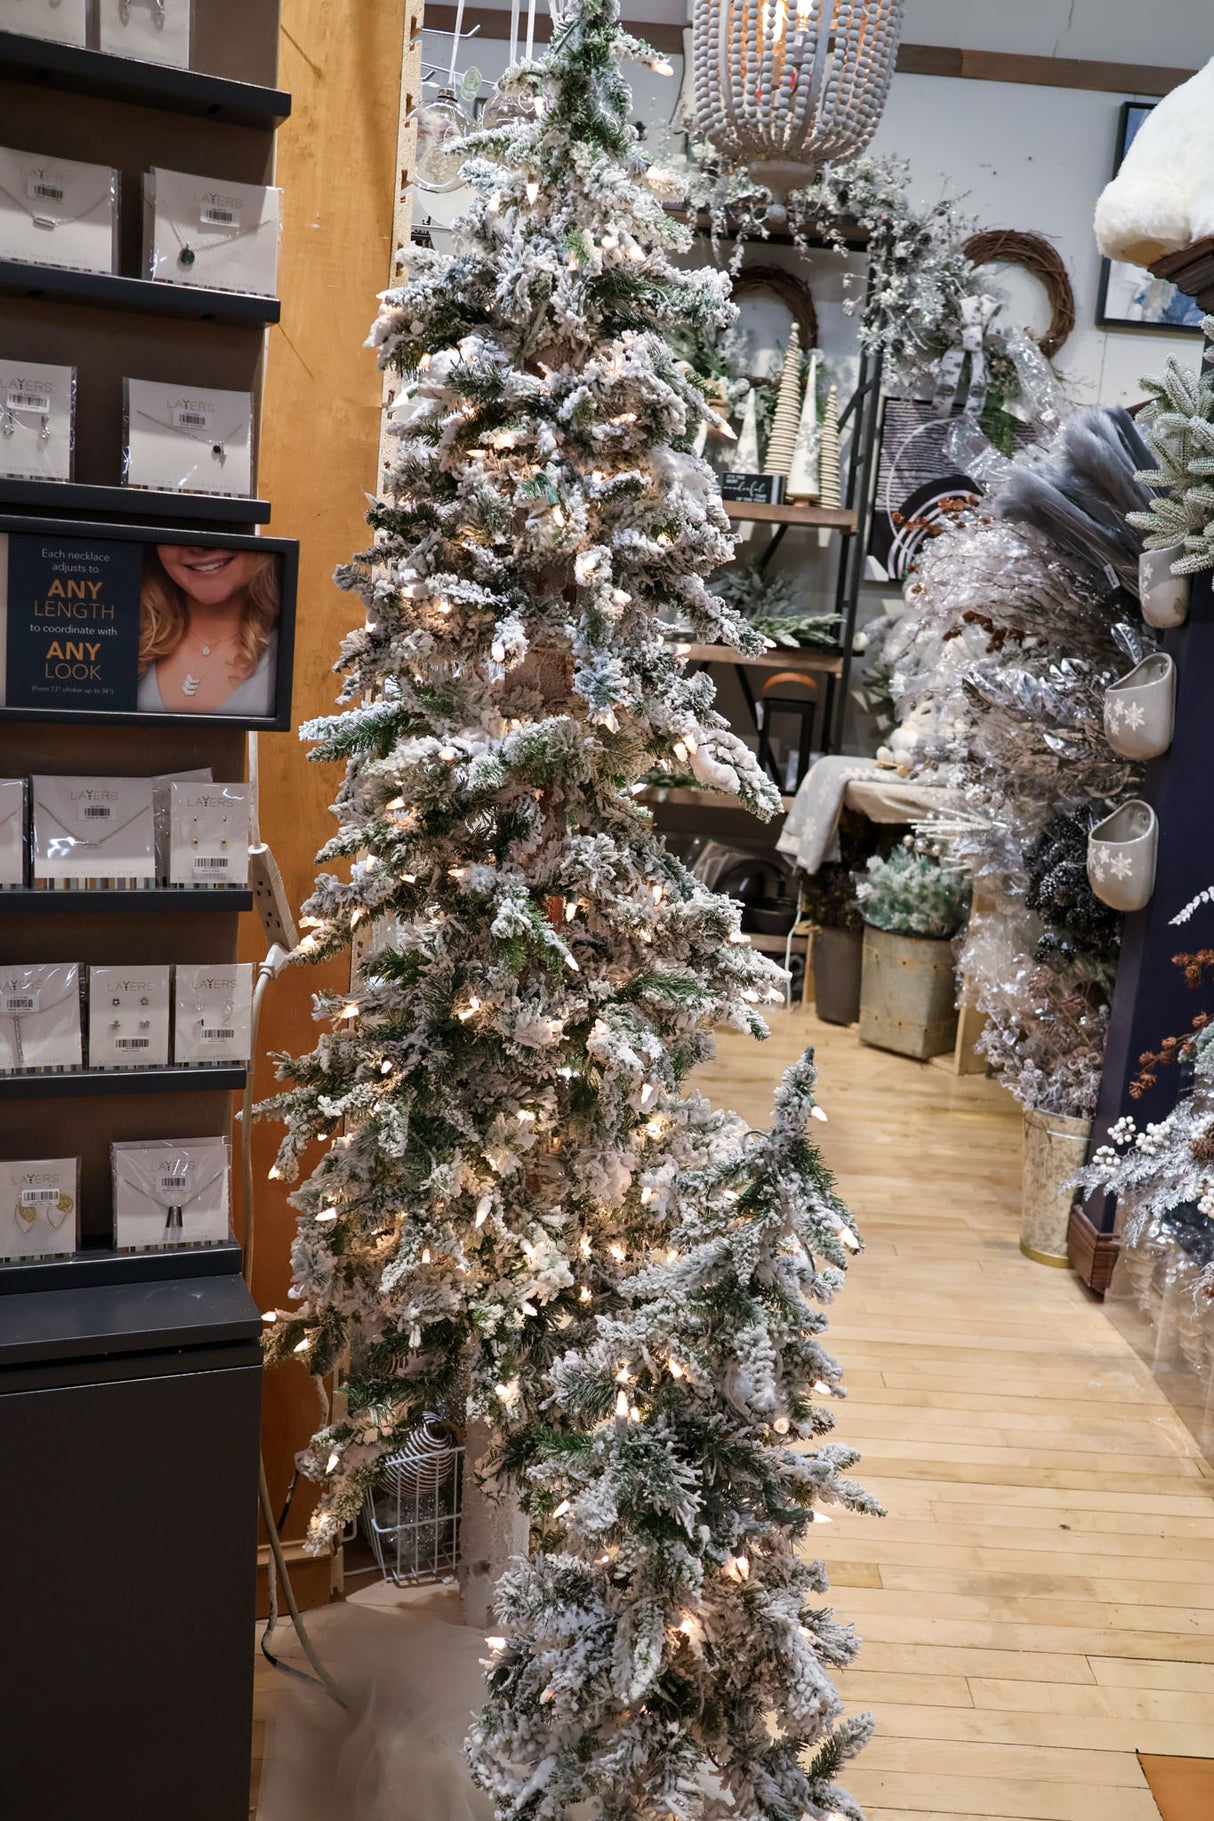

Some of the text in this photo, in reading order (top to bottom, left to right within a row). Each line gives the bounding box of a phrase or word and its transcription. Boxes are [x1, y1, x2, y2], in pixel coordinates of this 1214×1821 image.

[193, 191, 243, 209] LAYERS
[166, 398, 216, 414] LAYERS
[41, 548, 110, 562] Each necklace
[52, 562, 100, 574] adjusts to
[47, 578, 103, 600] ANY
[34, 600, 115, 619] LENGTH
[30, 624, 118, 636] to coordinate with
[46, 641, 101, 661] ANY
[45, 662, 102, 680] LOOK
[70, 789, 119, 801] LAYERS
[186, 796, 234, 808] LAYERS
[0, 979, 44, 991] AYERS
[107, 981, 153, 992] LAYERS
[192, 978, 237, 989] LAYERS
[11, 1174, 60, 1185] LAYERS
